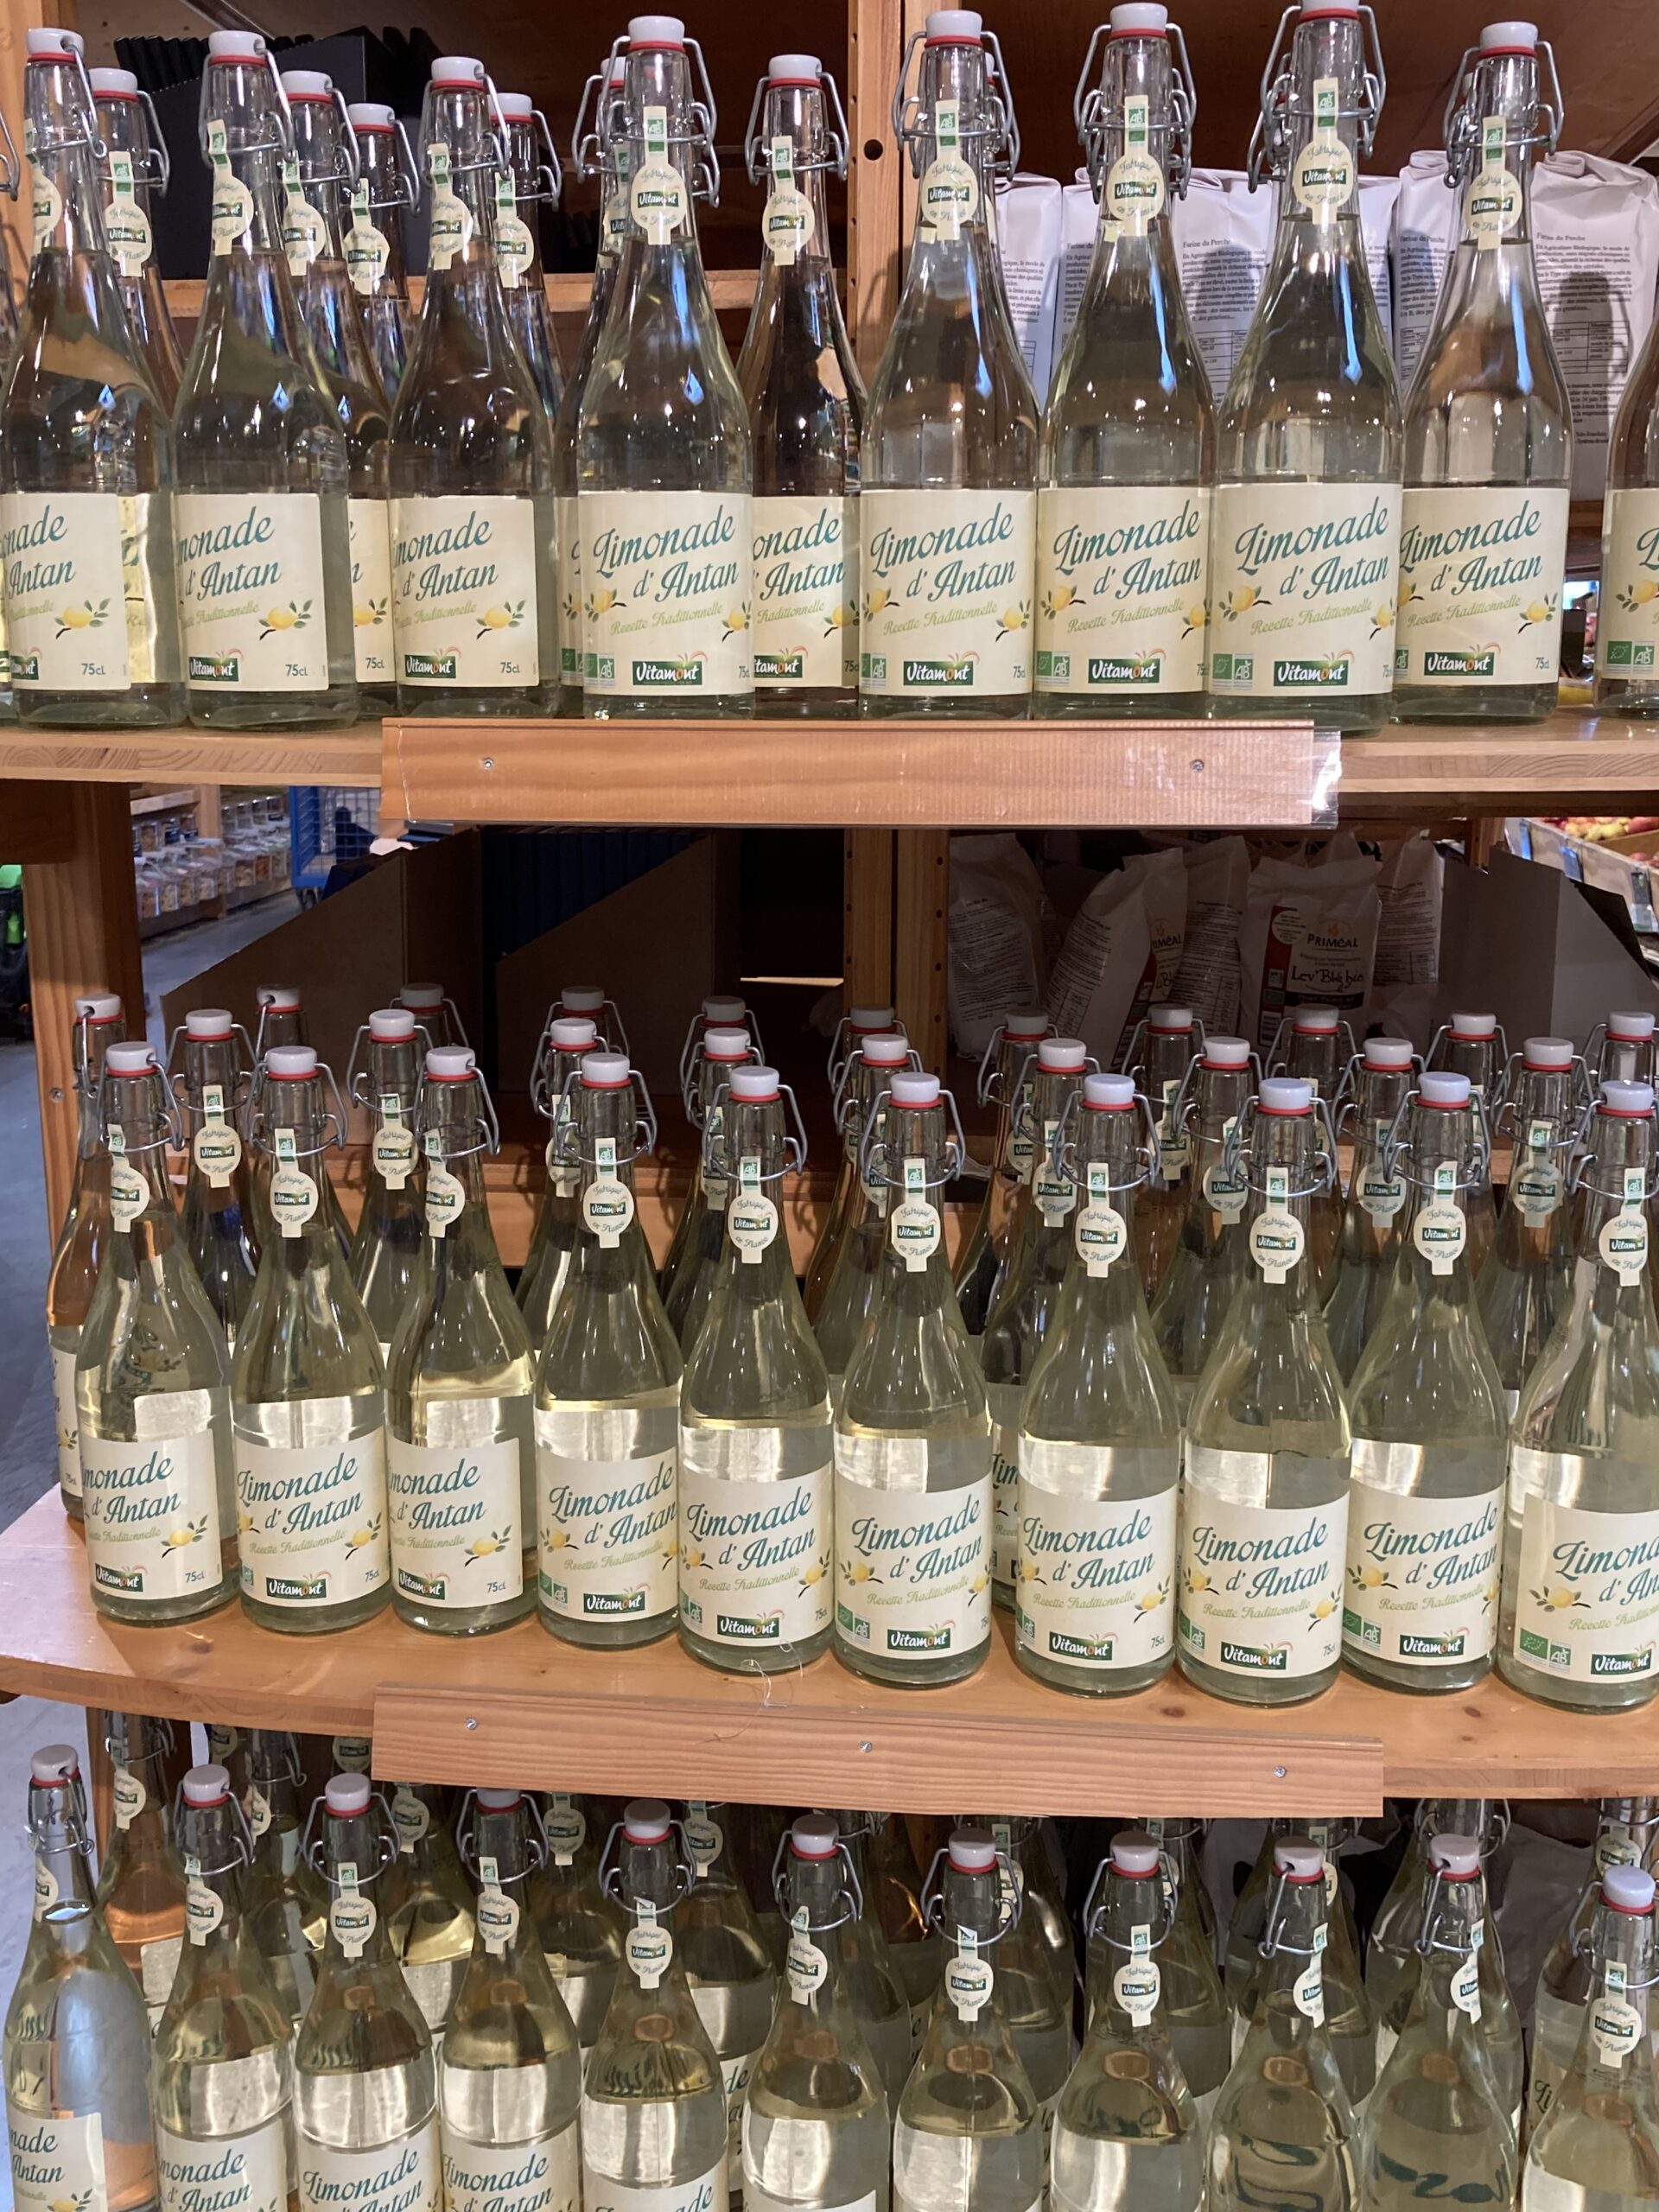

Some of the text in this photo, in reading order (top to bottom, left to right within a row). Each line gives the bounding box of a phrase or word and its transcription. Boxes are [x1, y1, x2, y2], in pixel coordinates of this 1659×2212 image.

[1304, 170, 1346, 184] Vitamont
[639, 193, 677, 207] Vitamont
[929, 187, 969, 202] Vitamont
[1116, 185, 1157, 199] Vitamont
[1471, 199, 1513, 213] Vitamont
[770, 217, 804, 231] Vitamont
[3, 505, 67, 557] nade
[178, 506, 275, 564] monade
[392, 511, 493, 569] monade
[753, 508, 842, 561] onade
[871, 502, 1014, 579] Limonade
[1053, 499, 1201, 575] Limonade
[1235, 496, 1389, 576] Limonade
[1400, 499, 1541, 574] Limonade
[593, 505, 735, 579] Limonade
[610, 601, 724, 637] Recette Traditionnelle
[883, 601, 998, 636] Recette Traditionnelle
[1067, 598, 1185, 633] Recette Traditionnelle
[1251, 598, 1372, 635] Recette Traditionnelle
[1408, 594, 1522, 628] Recette Traditionnelle
[190, 658, 235, 677] Vitamont
[406, 657, 454, 675] Vitamont
[636, 662, 699, 681] Vitamont
[907, 662, 970, 681] Vitamont
[1092, 660, 1158, 679] Vitamont
[1277, 662, 1345, 682] Vitamont
[1427, 653, 1491, 672] Vitamont
[201, 1147, 235, 1158] Vitamont
[378, 1148, 411, 1160] Vitamont
[276, 1193, 309, 1205] Vitamont
[591, 1205, 626, 1216] Vitamont
[734, 1217, 770, 1230] Vitamont
[899, 1227, 935, 1237] Vitamont
[1423, 1228, 1460, 1240] Vitamont
[1081, 1230, 1118, 1243] Vitamont
[1257, 1236, 1296, 1249] Vitamont
[1611, 1239, 1644, 1252] Vitamont
[83, 1451, 174, 1490] monade
[238, 1452, 359, 1507] Limonade
[390, 1458, 480, 1495] monade
[550, 1461, 675, 1524] Limonade
[687, 1486, 812, 1542] Limonade
[852, 1494, 981, 1556] Limonade
[1023, 1510, 1153, 1555] Limonade
[1363, 1501, 1497, 1561] Limonade
[250, 1529, 346, 1554] Recette Traditionnelle
[1192, 1516, 1328, 1566] Limonade
[564, 1540, 663, 1570] Recette Traditionnelle
[97, 1567, 139, 1588] Vitamont
[400, 1571, 442, 1595] Vitamont
[699, 1566, 800, 1591] Recette Traditionnelle
[270, 1580, 324, 1597] Vitamont
[867, 1575, 969, 1605] Recette Traditionnelle
[1379, 1583, 1484, 1611] Recette Traditionnelle
[587, 1595, 641, 1611] Vitamont
[1033, 1590, 1137, 1609] Recette Traditionnelle
[1202, 1599, 1311, 1618] Recette Traditionnelle
[720, 1618, 777, 1634] Vitamont
[1569, 1618, 1611, 1630] Recette
[891, 1630, 948, 1647] Vitamont
[1052, 1635, 1109, 1656] Vitamont
[1403, 1636, 1462, 1655] Vitamont
[1224, 1644, 1283, 1666] Vitamont
[1595, 1651, 1649, 1672] Vitamont
[632, 1946, 664, 1958] Vitamont
[952, 1977, 986, 1990] Vitamont
[1123, 1984, 1156, 1995] Vitamont
[1596, 2020, 1632, 2036] Vitamont
[10, 2127, 58, 2153] nade
[159, 2149, 246, 2183] monade
[303, 2149, 419, 2204] Limonade
[443, 2153, 549, 2193] Limonade
